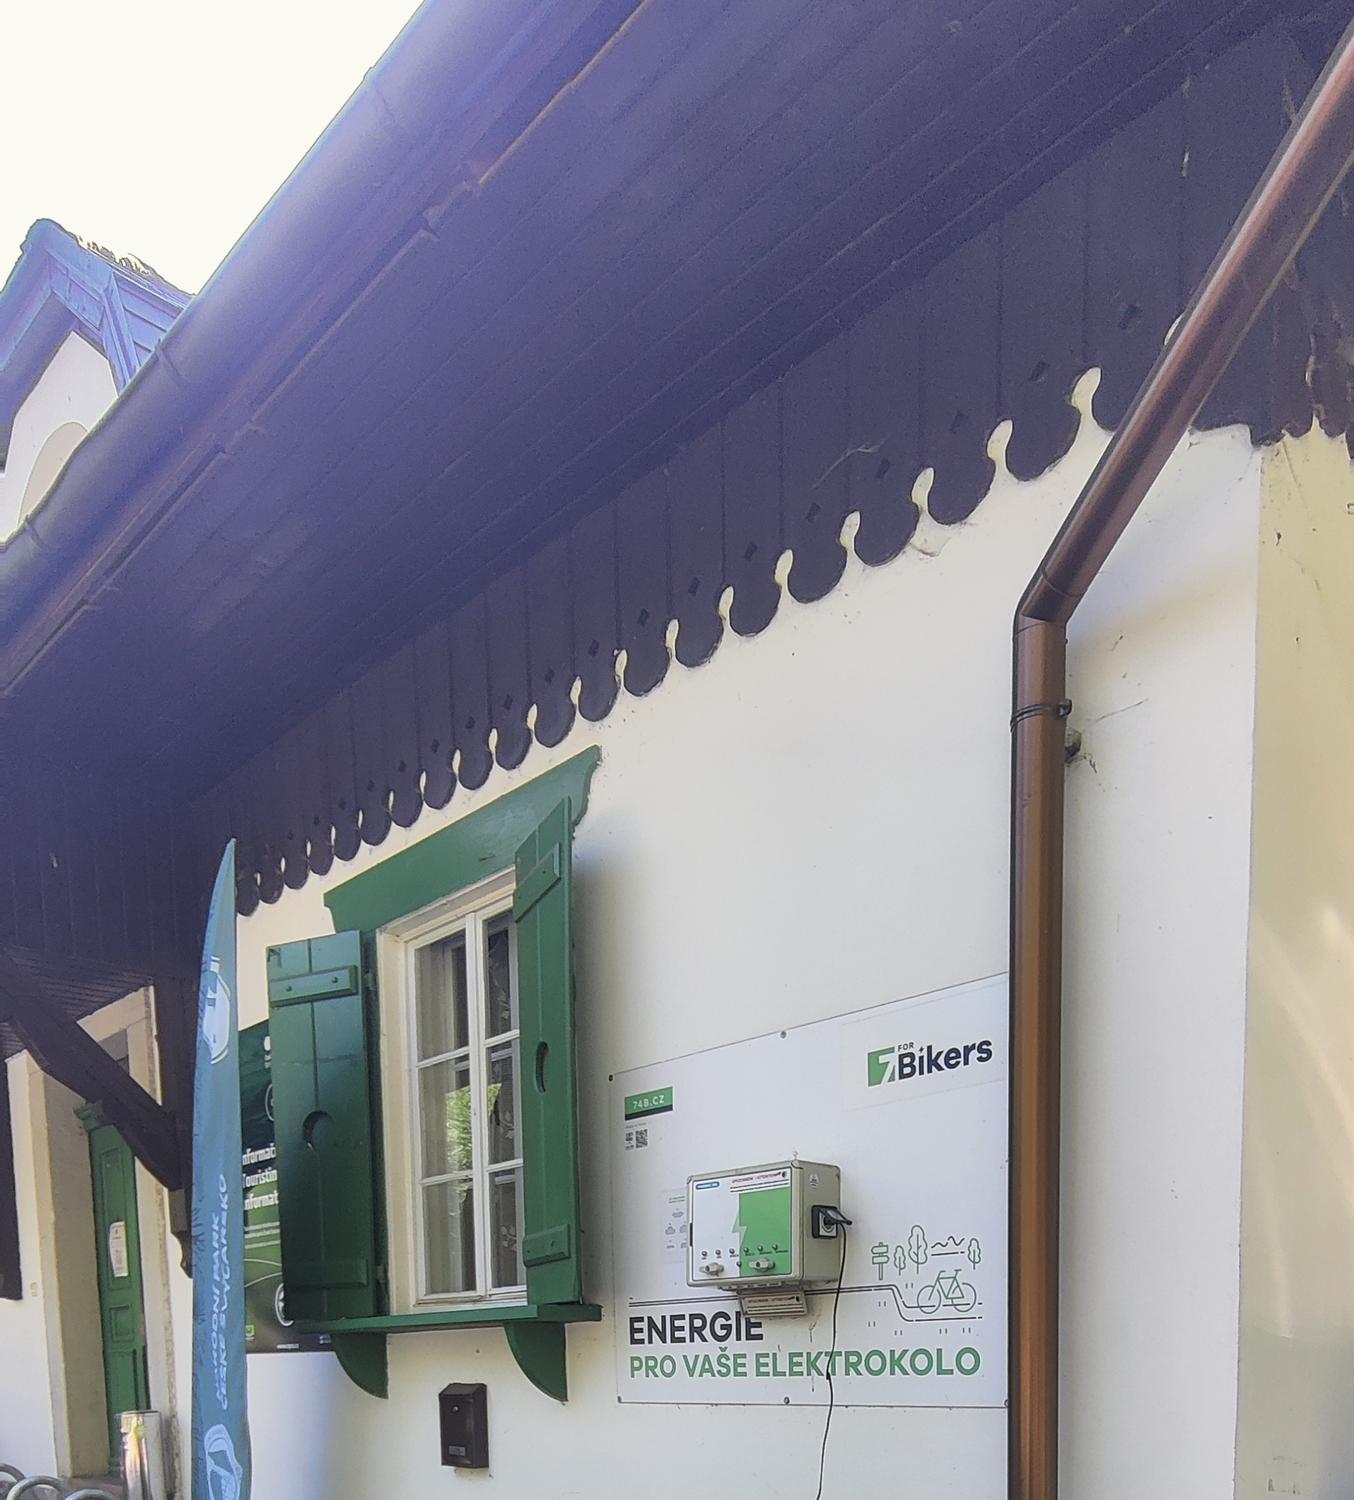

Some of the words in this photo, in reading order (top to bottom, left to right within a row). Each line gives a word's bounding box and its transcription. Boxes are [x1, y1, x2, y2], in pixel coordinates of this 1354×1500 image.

[897, 1041, 915, 1052] FOR
[898, 1039, 993, 1080] Bikers
[628, 1310, 764, 1345] ENERGIE
[629, 1354, 677, 1379] PRO
[682, 1345, 748, 1378] VAŠE
[754, 1346, 981, 1378] ELEKTROKOLO
